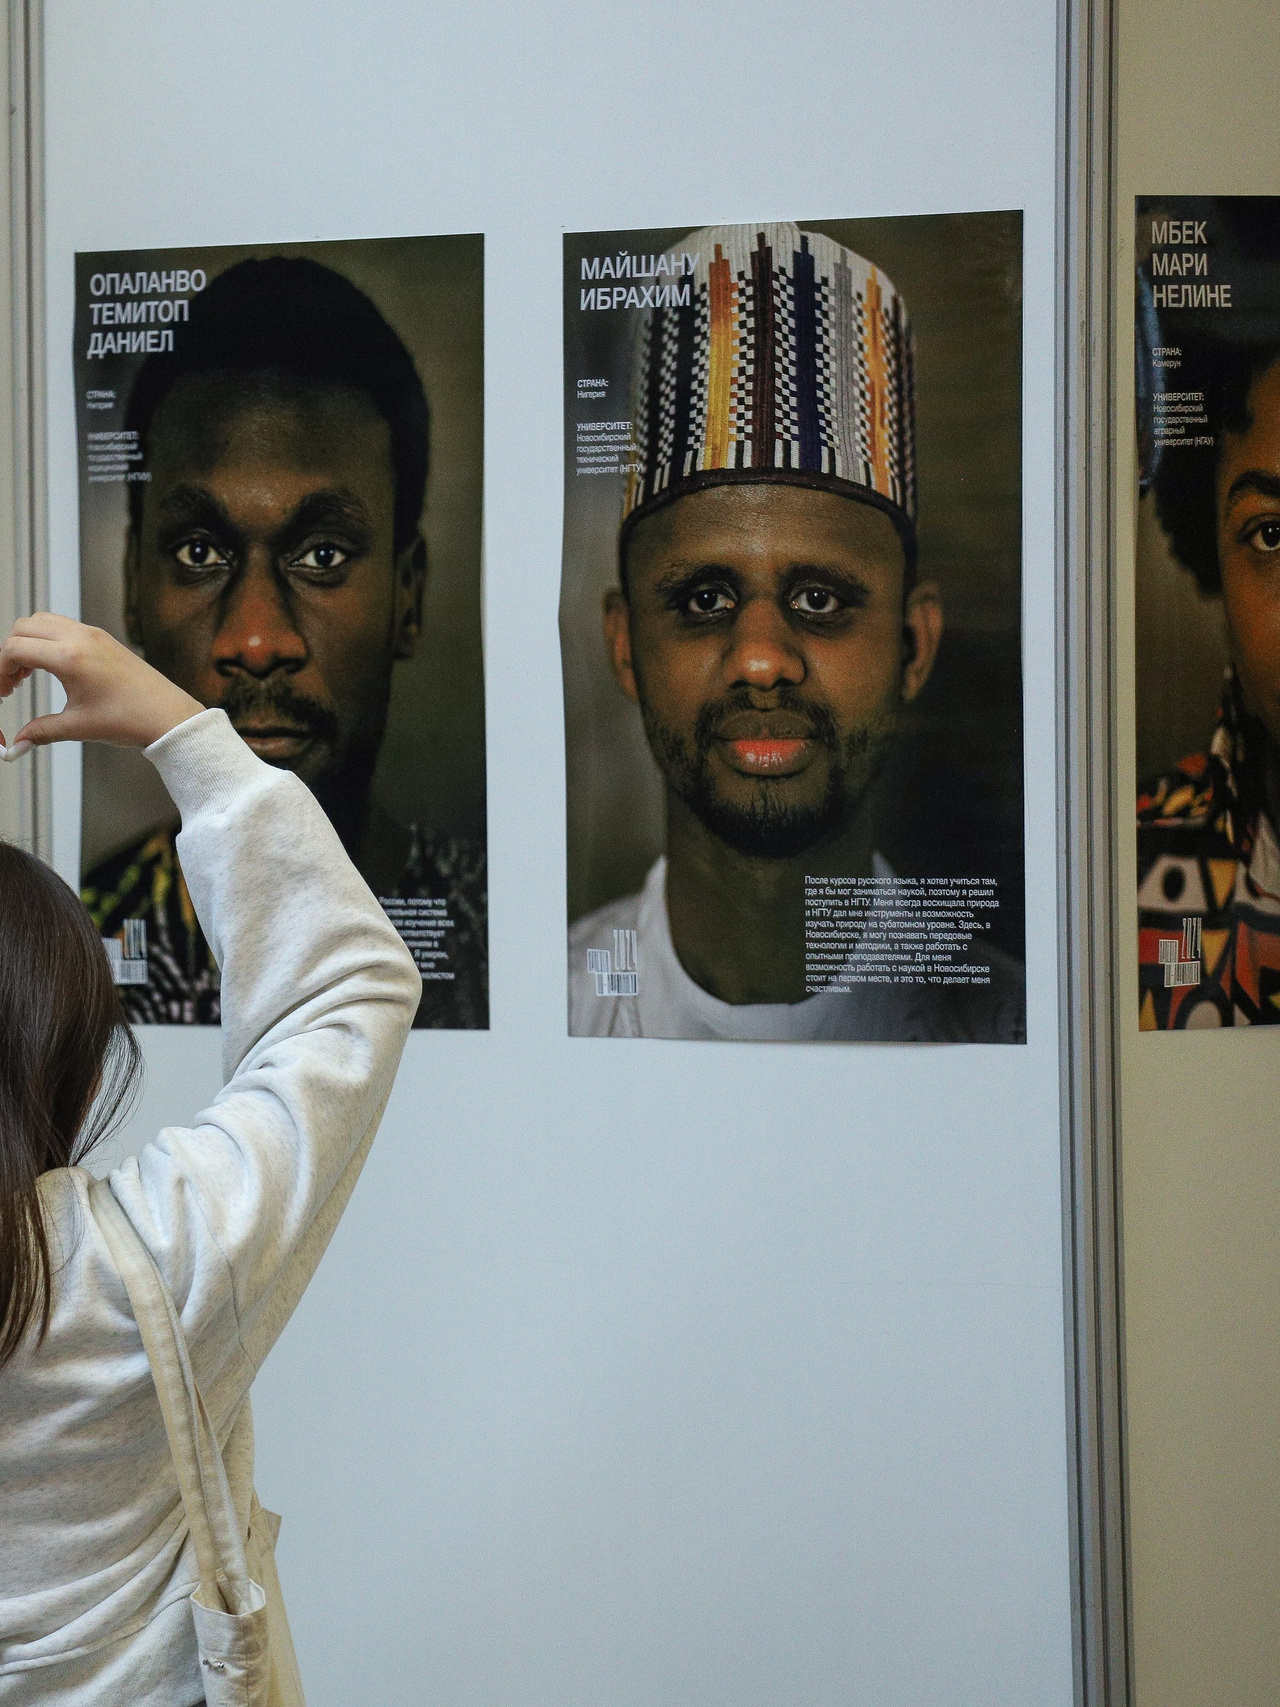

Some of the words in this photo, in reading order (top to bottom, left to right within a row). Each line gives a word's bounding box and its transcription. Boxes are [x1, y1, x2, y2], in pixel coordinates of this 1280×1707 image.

[1152, 221, 1207, 244] МБЕК
[581, 251, 699, 280] МАЙШАНУ
[1152, 253, 1207, 275] МАРИ
[90, 269, 206, 296] ОПАЛАНВО
[580, 284, 690, 310] ИБРАХИМ
[1153, 285, 1231, 308] НЕЛИНЕ
[90, 300, 189, 325] ТЕМИТОП
[87, 330, 174, 359] ДАНИЕЛ
[1152, 359, 1181, 368] Камерун
[577, 380, 608, 388] СТРАНА:
[577, 390, 605, 399] Нигерия
[1153, 393, 1204, 401] УНИВЕРСИТЕТ:
[1153, 404, 1203, 413] Новосибирский
[1154, 415, 1208, 424] государственный
[577, 422, 632, 431] УНИВЕРСИТЕТ:
[1154, 426, 1185, 435] аграрный
[577, 433, 630, 442] Новосибирский
[1154, 438, 1193, 446] университет
[1195, 437, 1213, 446] (НГАУ)
[577, 444, 636, 453] государственный
[577, 466, 617, 475] университет
[620, 464, 645, 474] (НГТУ)
[805, 876, 828, 884] После
[825, 887, 836, 895] бы
[898, 887, 927, 897] наукой,
[851, 898, 871, 906] НГТУ.
[873, 898, 893, 906] Меня
[812, 908, 831, 916] НГТУ
[879, 920, 925, 929] субатомном
[958, 920, 984, 930] Здесь,
[805, 930, 861, 940] Новосибирске,
[926, 942, 961, 951] работать
[915, 952, 930, 962] Для
[857, 963, 890, 972] работать
[898, 963, 925, 973] наукой
[934, 964, 989, 973] Новосибирске
